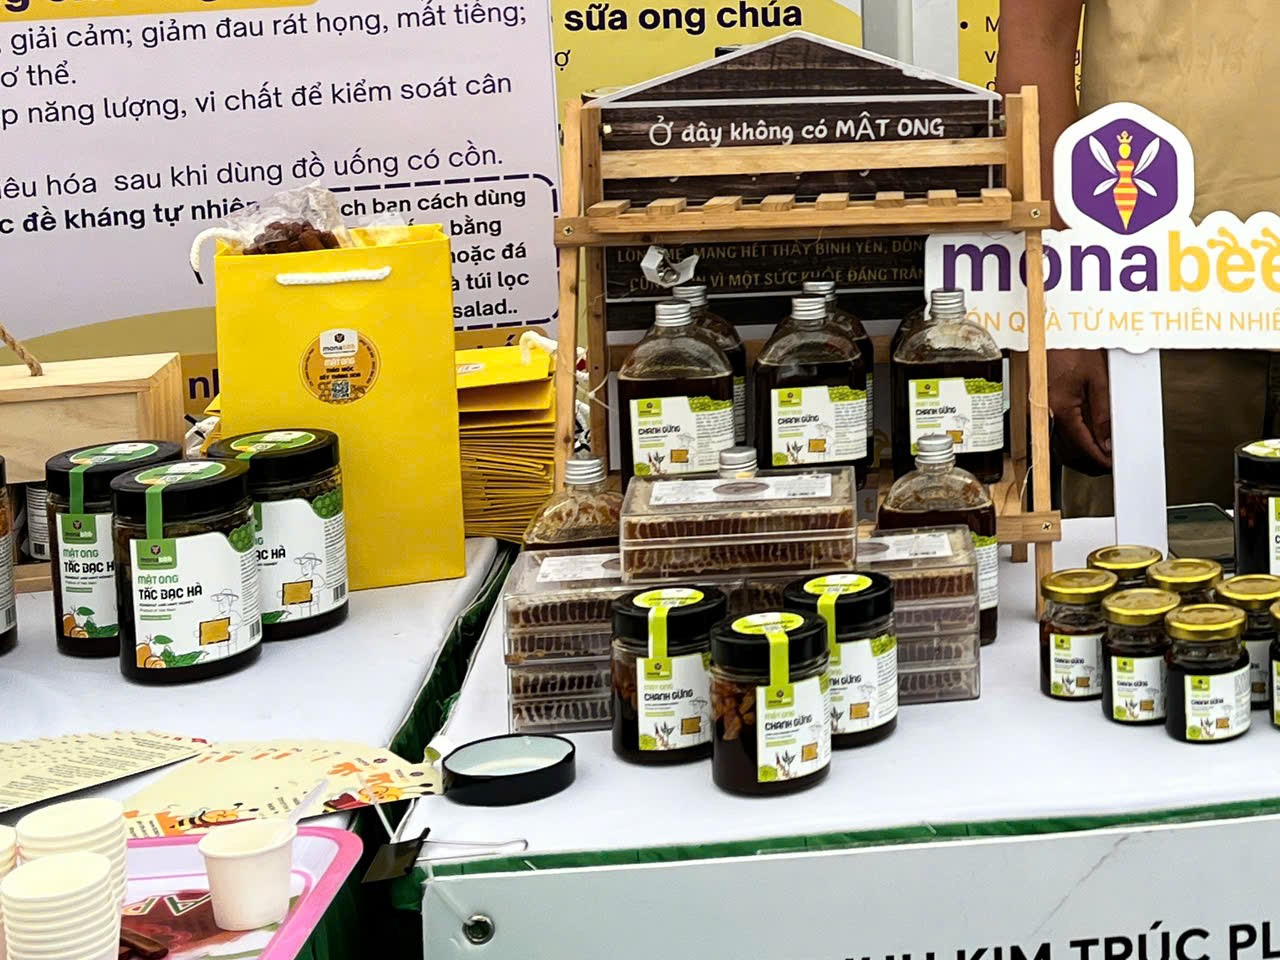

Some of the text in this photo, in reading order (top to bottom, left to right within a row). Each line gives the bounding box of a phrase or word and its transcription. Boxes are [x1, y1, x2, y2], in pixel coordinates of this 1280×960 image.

[12, 25, 60, 57] giải
[66, 18, 133, 48] cảm;
[141, 19, 206, 50] giảm
[216, 16, 264, 40] đau
[272, 12, 309, 36] rát
[316, 7, 389, 41] họng,
[397, 1, 446, 28] mất
[564, 1, 801, 36] sữa ong chúa
[649, 115, 675, 147] Ở
[681, 121, 722, 148] đây
[730, 120, 794, 146] không
[802, 118, 828, 139] có
[897, 118, 945, 137] ONG
[1068, 307, 1103, 331] TỪ
[1110, 311, 1144, 337] MẸ
[1154, 307, 1222, 331] THIÊN
[159, 574, 179, 585] ONG
[187, 582, 203, 598] HÀ
[1070, 920, 1210, 960] TRÚC
